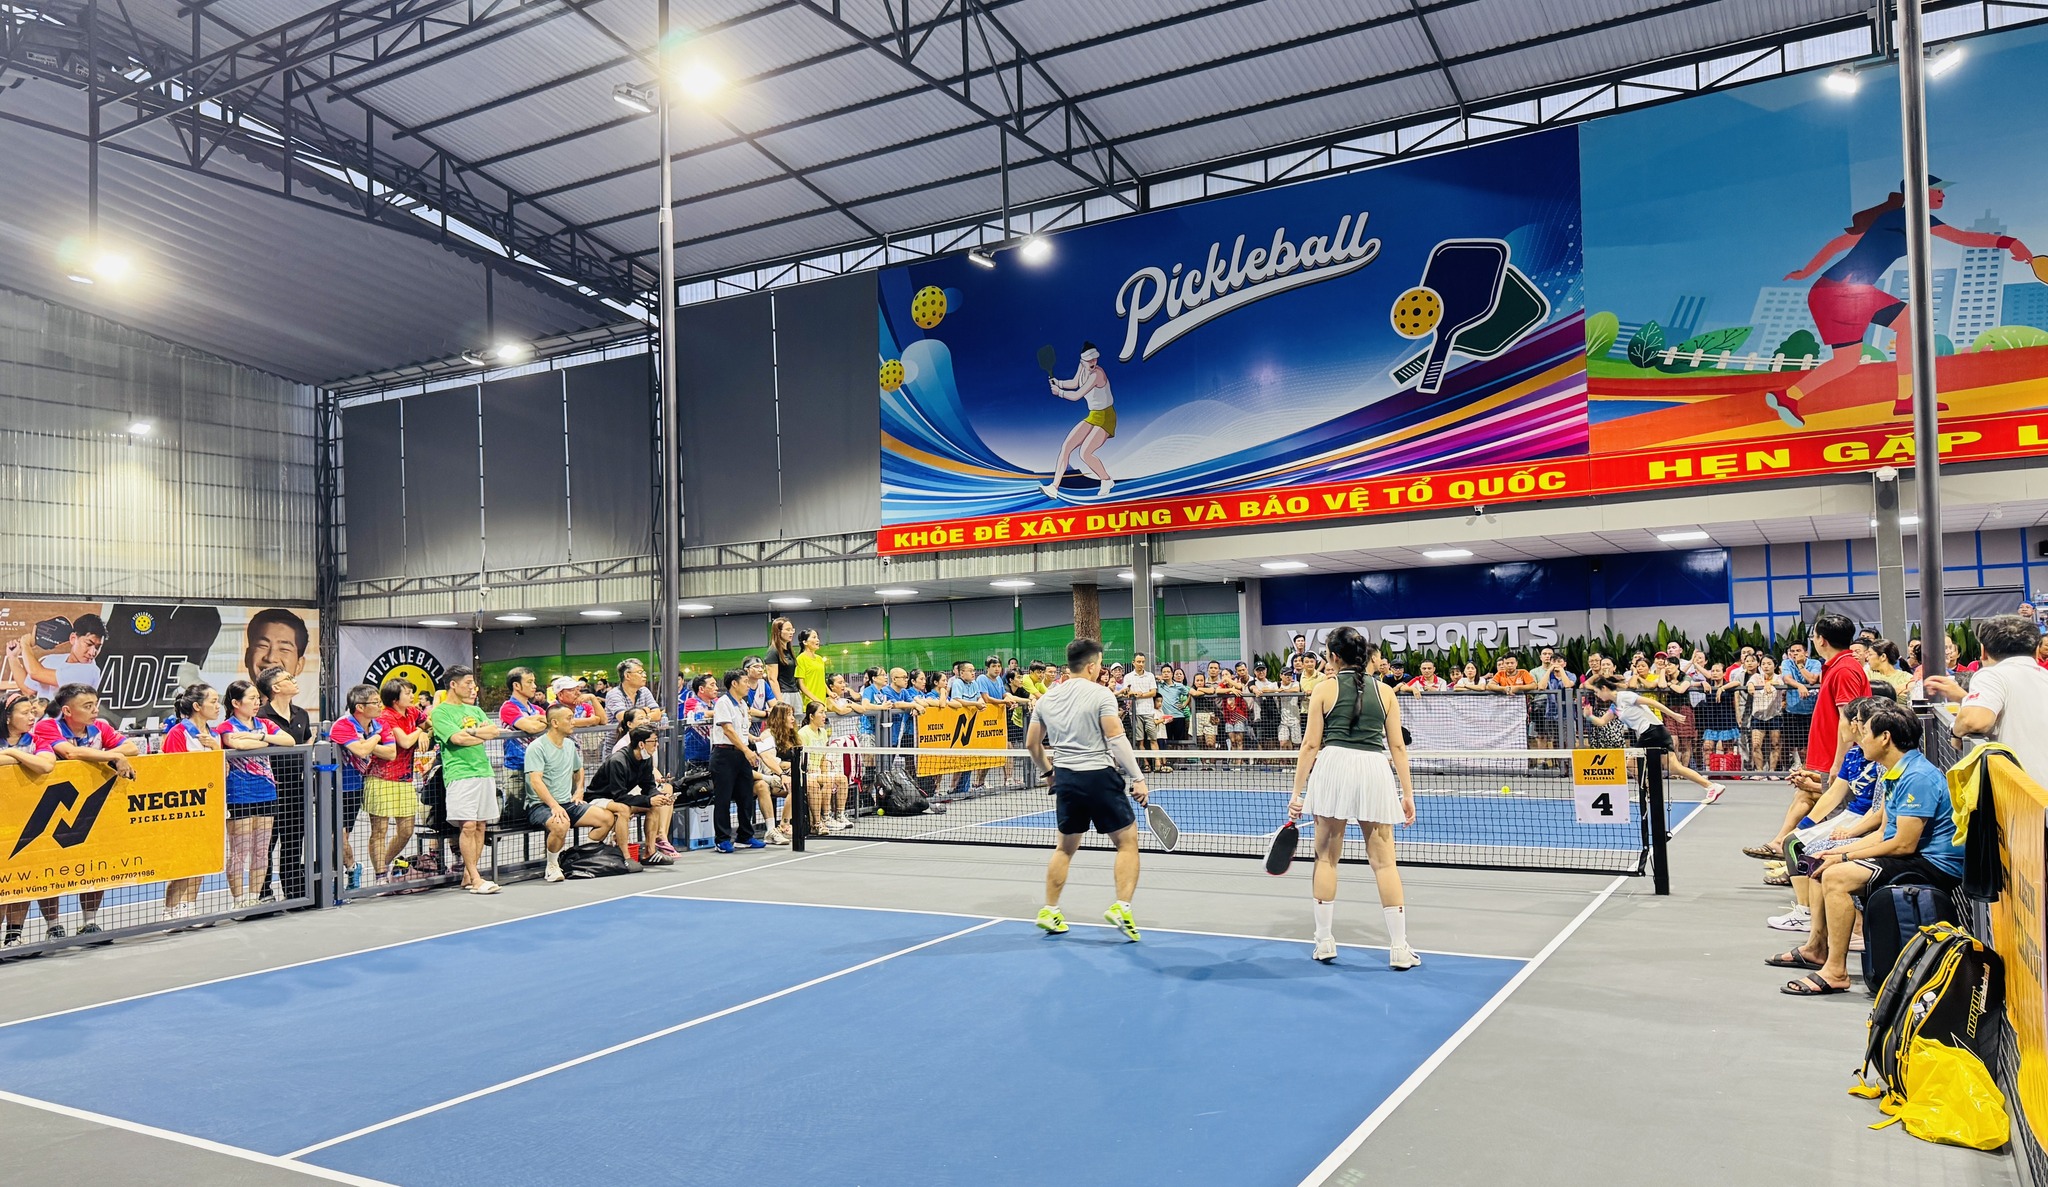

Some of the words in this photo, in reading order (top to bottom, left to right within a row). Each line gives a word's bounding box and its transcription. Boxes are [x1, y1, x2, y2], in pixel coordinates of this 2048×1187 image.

[1115, 211, 1381, 362] Pickleball
[1648, 448, 1790, 480] HẸN
[894, 525, 964, 548] KHỎE
[973, 517, 1011, 541] ĐỂ
[1020, 516, 1076, 537] XÂY
[1086, 509, 1172, 532] DỰNG
[1183, 500, 1228, 522] VÀ
[1239, 494, 1310, 518] BẢO
[1322, 487, 1370, 513] VỆ
[1382, 476, 1433, 505] TỔ
[1448, 465, 1566, 500] QUỐC
[1380, 617, 1559, 653] SPORTS
[366, 649, 443, 684] PICKLEBALL
[919, 733, 951, 743] PHANTOM
[976, 729, 1004, 738] PHANTOM
[1583, 768, 1615, 776] NEGIN
[127, 788, 207, 812] NEGIN
[1591, 792, 1614, 816] 4
[130, 810, 205, 824] PICKLEBALL
[25, 884, 48, 893] Vũng
[67, 880, 78, 888] Mr
